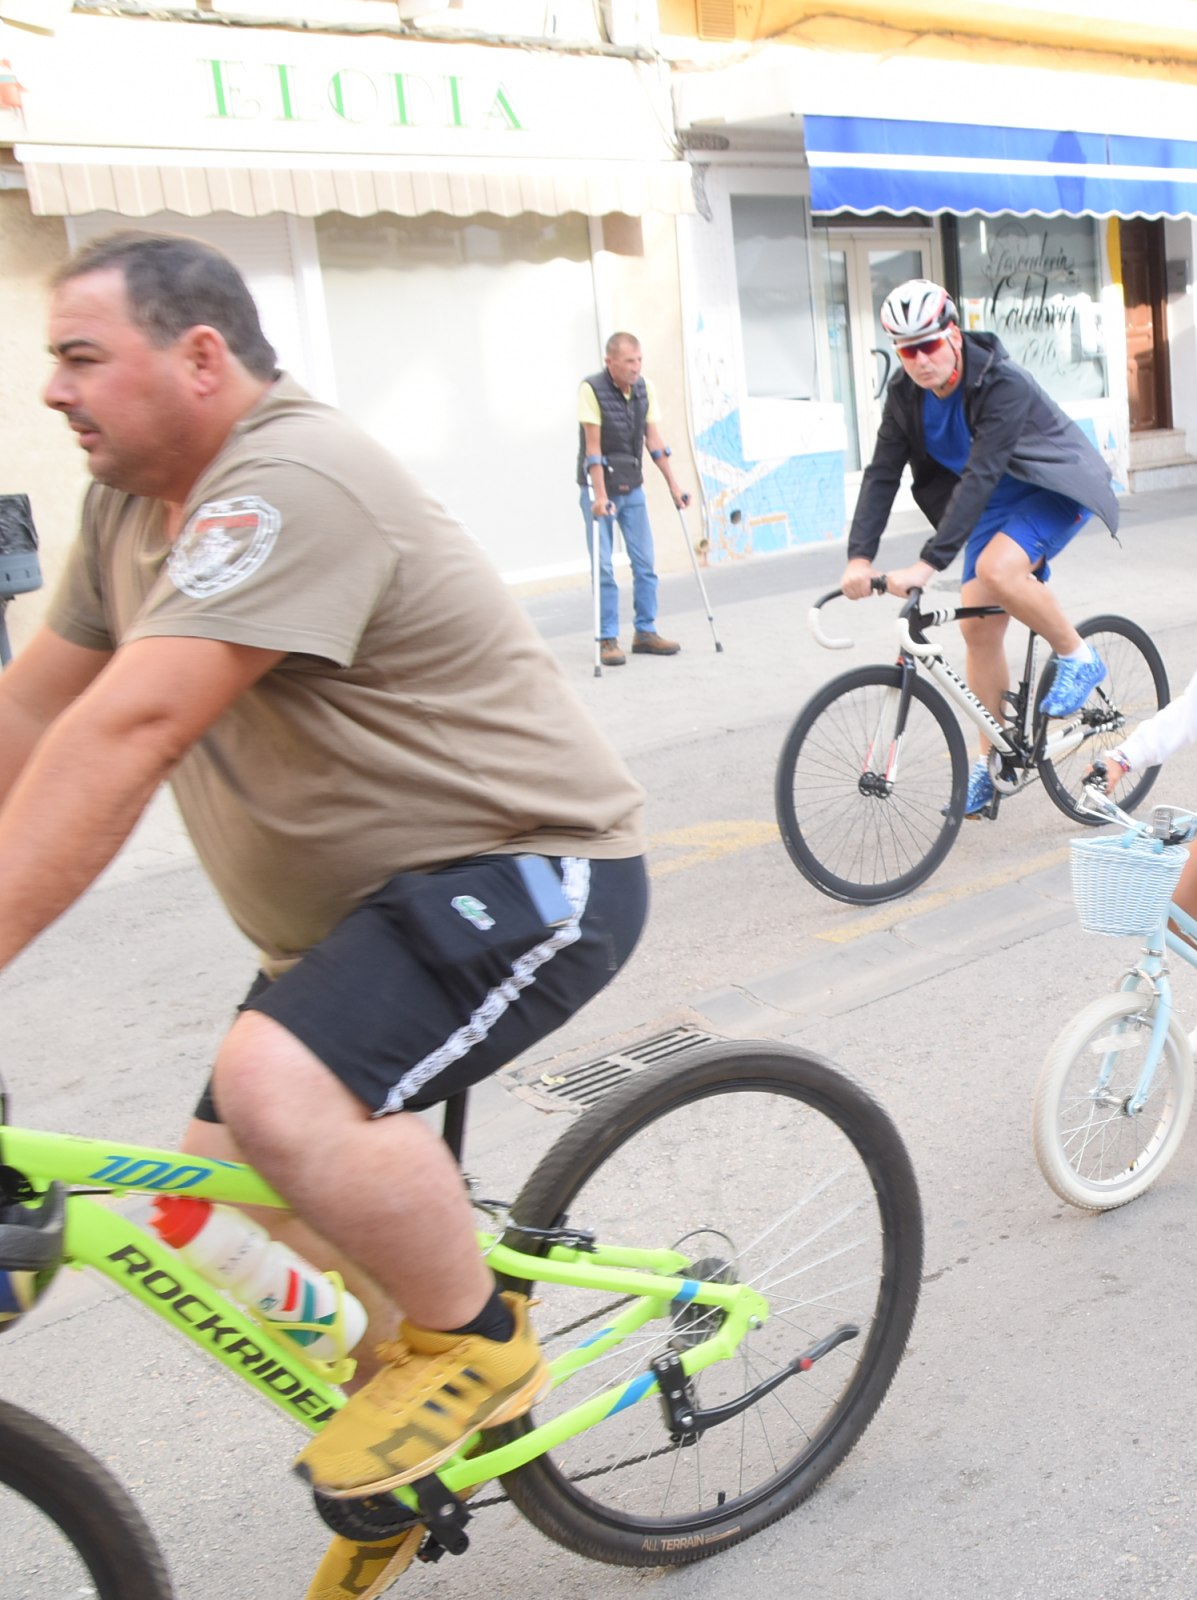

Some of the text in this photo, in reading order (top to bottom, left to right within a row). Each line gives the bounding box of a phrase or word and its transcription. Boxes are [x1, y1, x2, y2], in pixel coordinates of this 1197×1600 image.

[87, 1155, 213, 1190] 100
[641, 1533, 705, 1552] ALL TERRAIN
